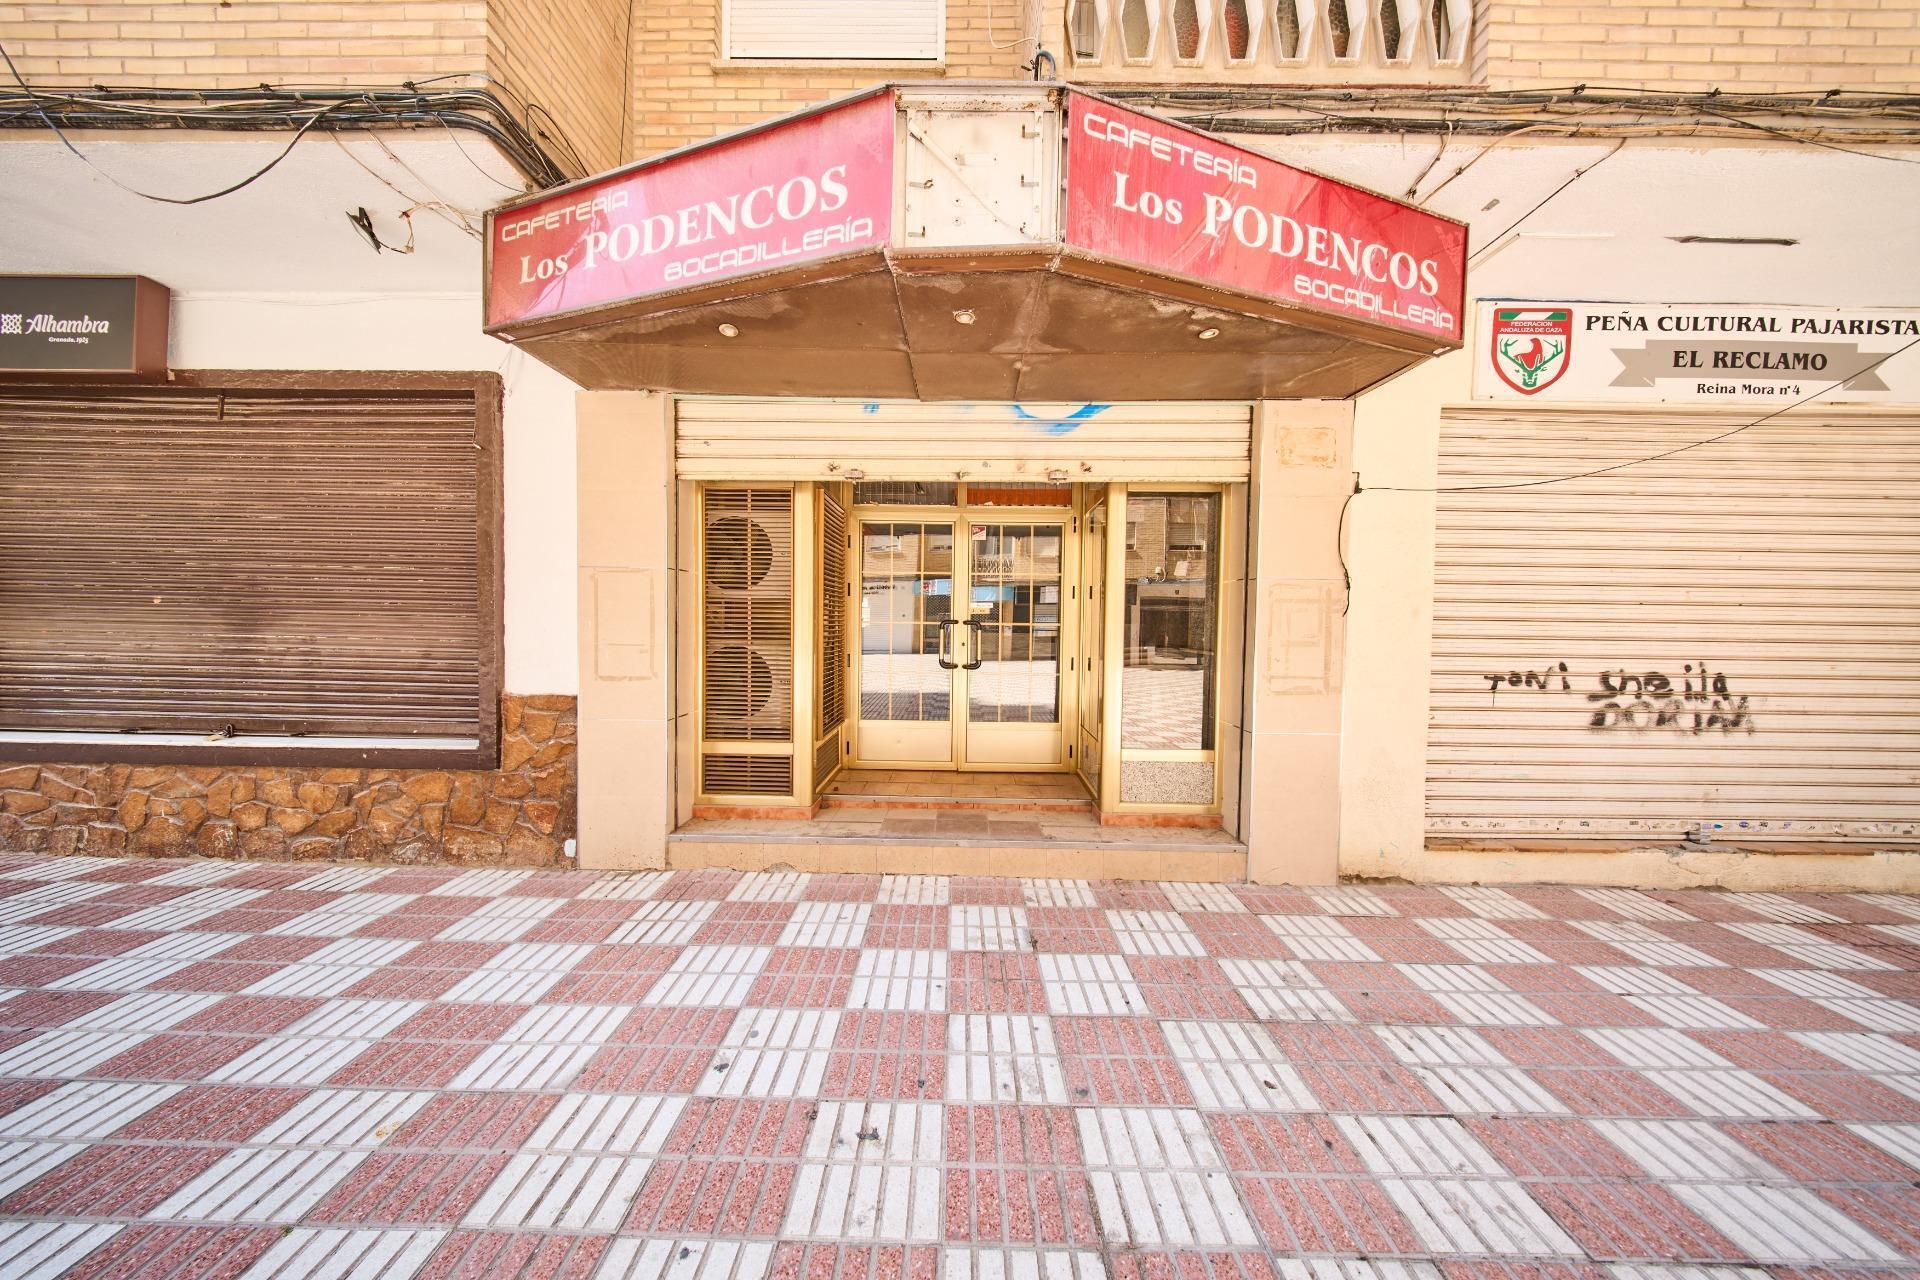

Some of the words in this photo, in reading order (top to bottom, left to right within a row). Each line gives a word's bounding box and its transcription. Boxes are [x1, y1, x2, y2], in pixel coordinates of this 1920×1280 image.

[1083, 112, 1257, 189] CAFETERÍA
[501, 190, 629, 243] CAFETERÍA
[519, 254, 569, 284] Los
[582, 164, 850, 271] PODENCOS
[1112, 170, 1183, 225] Los
[1201, 190, 1439, 297] PODENCOS
[664, 216, 874, 282] BOCADILLERÍA
[25, 314, 110, 335] Alhambra
[1294, 273, 1454, 331] BOCADILLERÍA
[1585, 310, 1649, 331] PEÑA
[1657, 315, 1782, 333] CULTURAL
[1790, 318, 1920, 335] PAJARISTA
[1672, 350, 1704, 368] EL
[1712, 351, 1828, 371] RECLAMO
[1696, 383, 1736, 394] Reina
[1741, 384, 1774, 395] Mora
